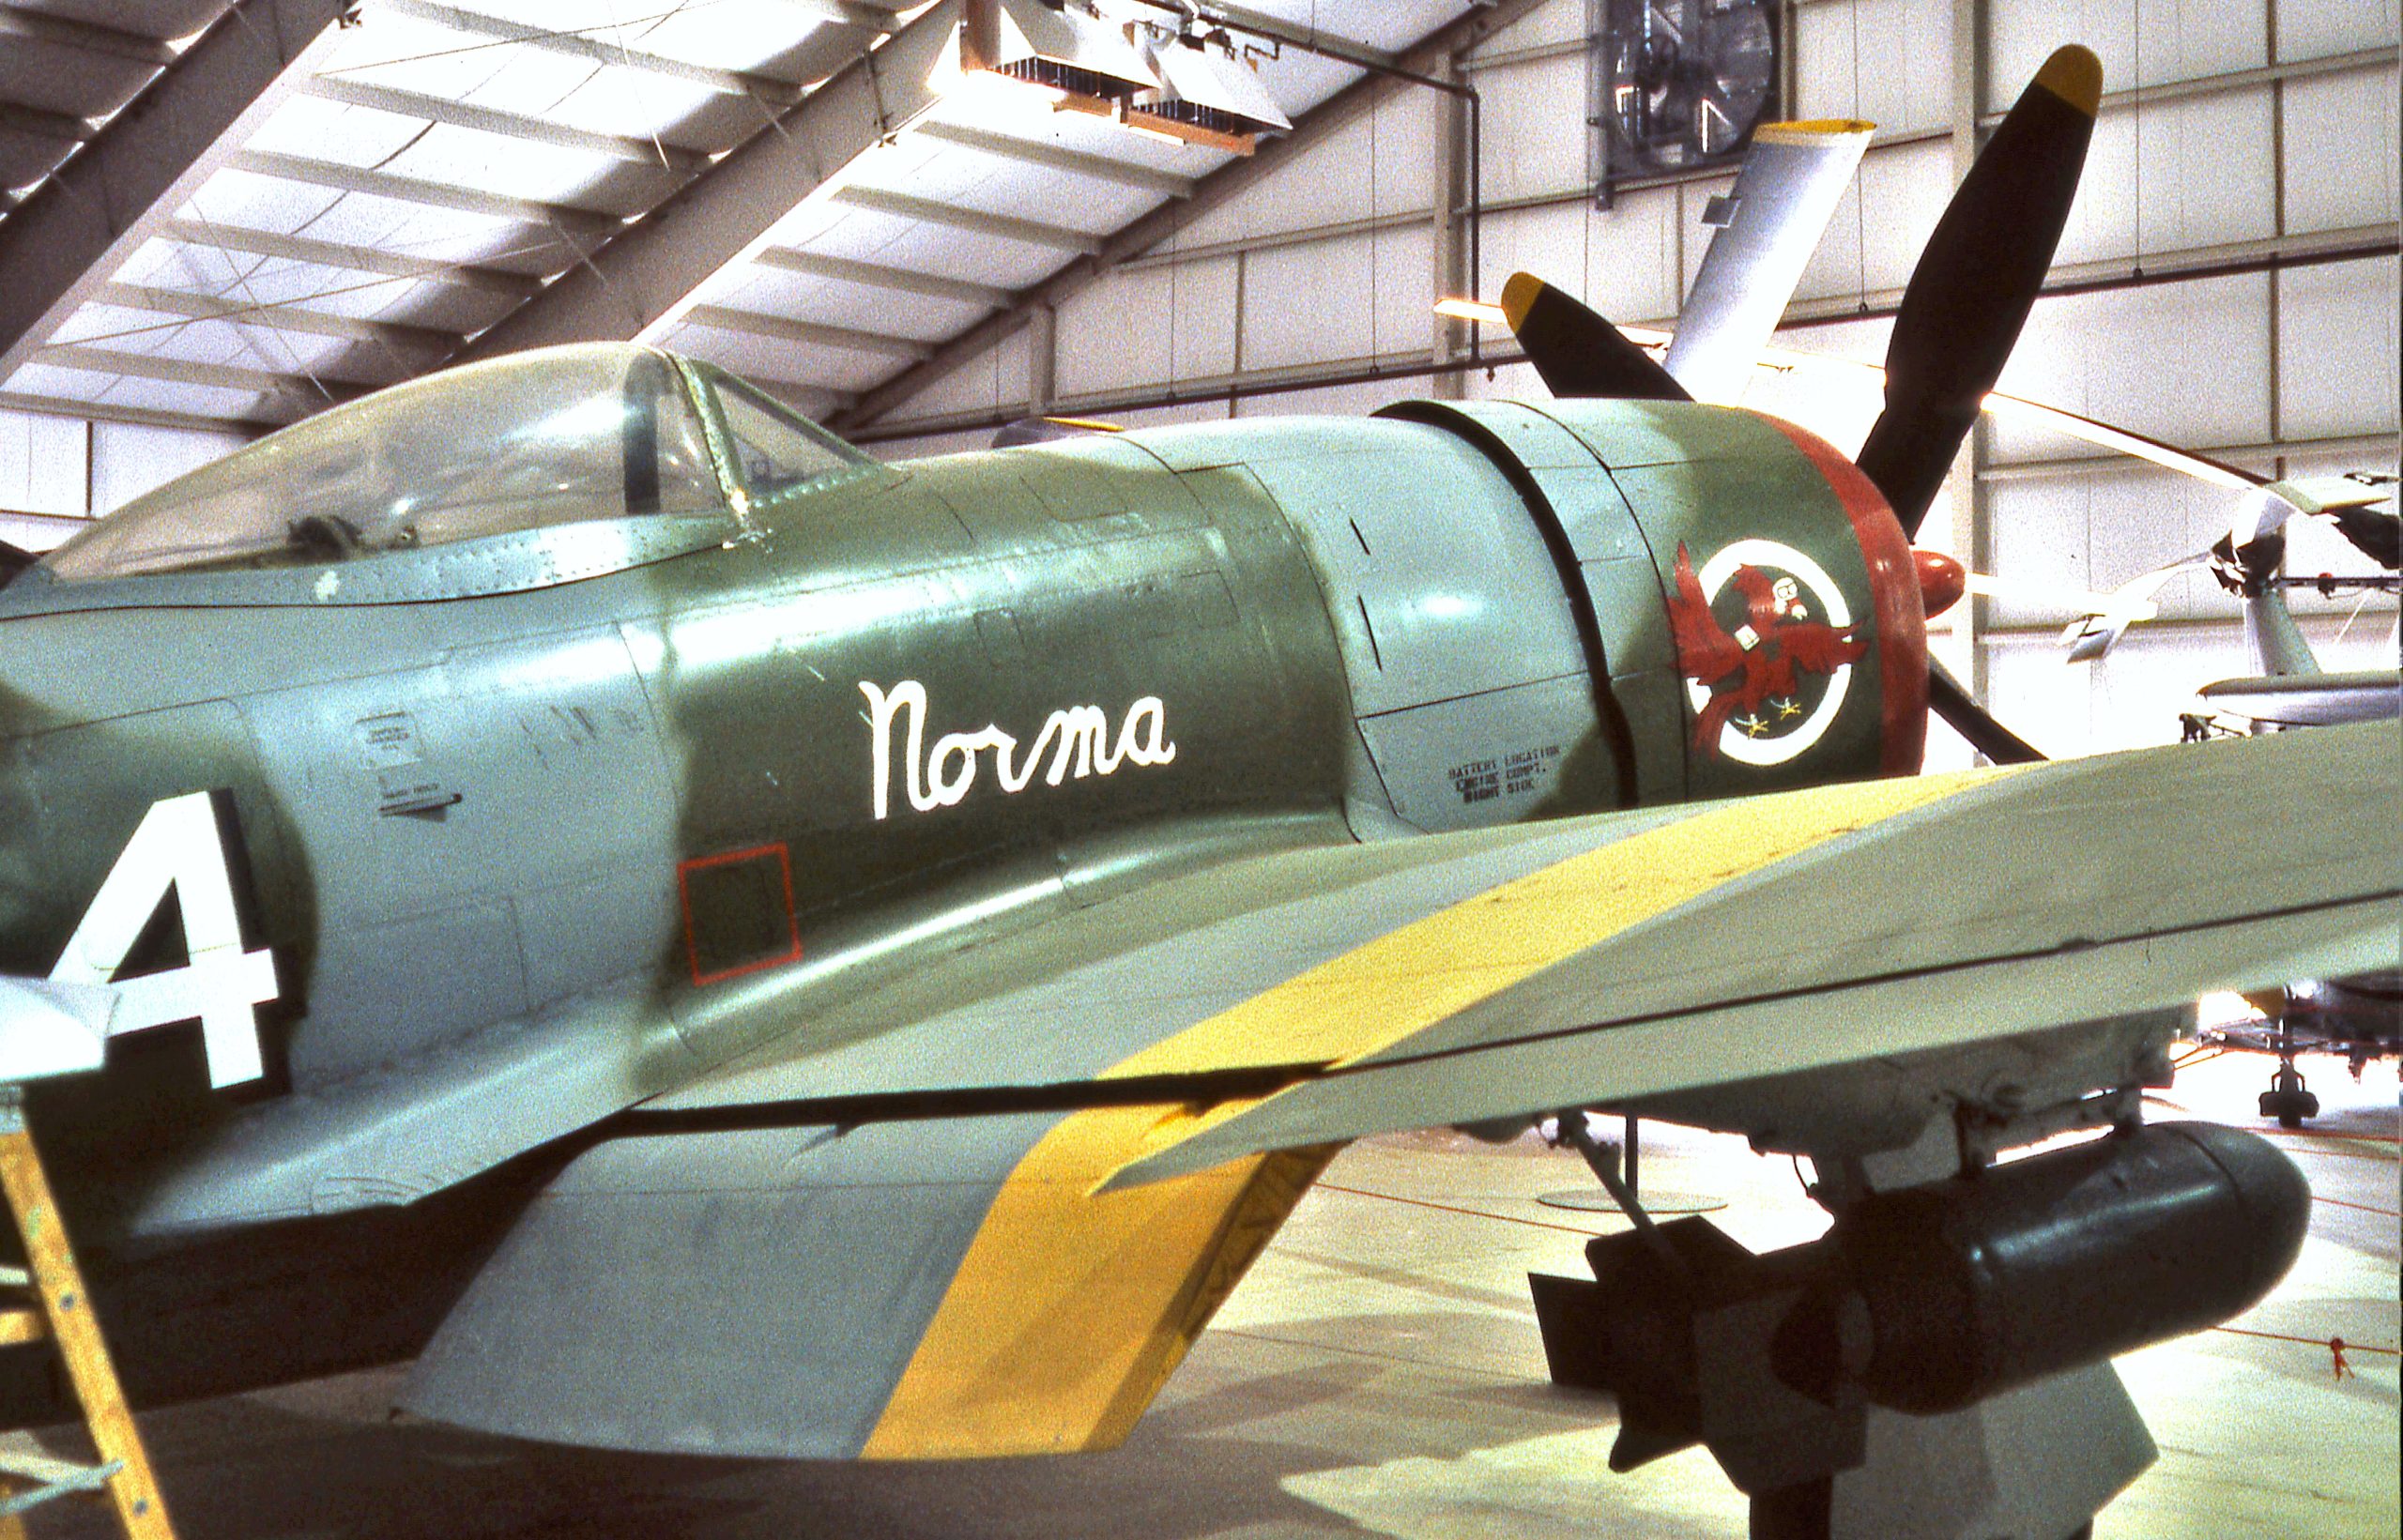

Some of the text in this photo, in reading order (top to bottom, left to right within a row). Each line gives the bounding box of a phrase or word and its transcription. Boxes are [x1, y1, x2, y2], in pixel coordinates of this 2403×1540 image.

[858, 679, 1177, 821] Norma
[1447, 745, 1560, 780] BATTERY LOCATION
[1507, 777, 1535, 794] SIDE
[48, 789, 280, 1090] 4
